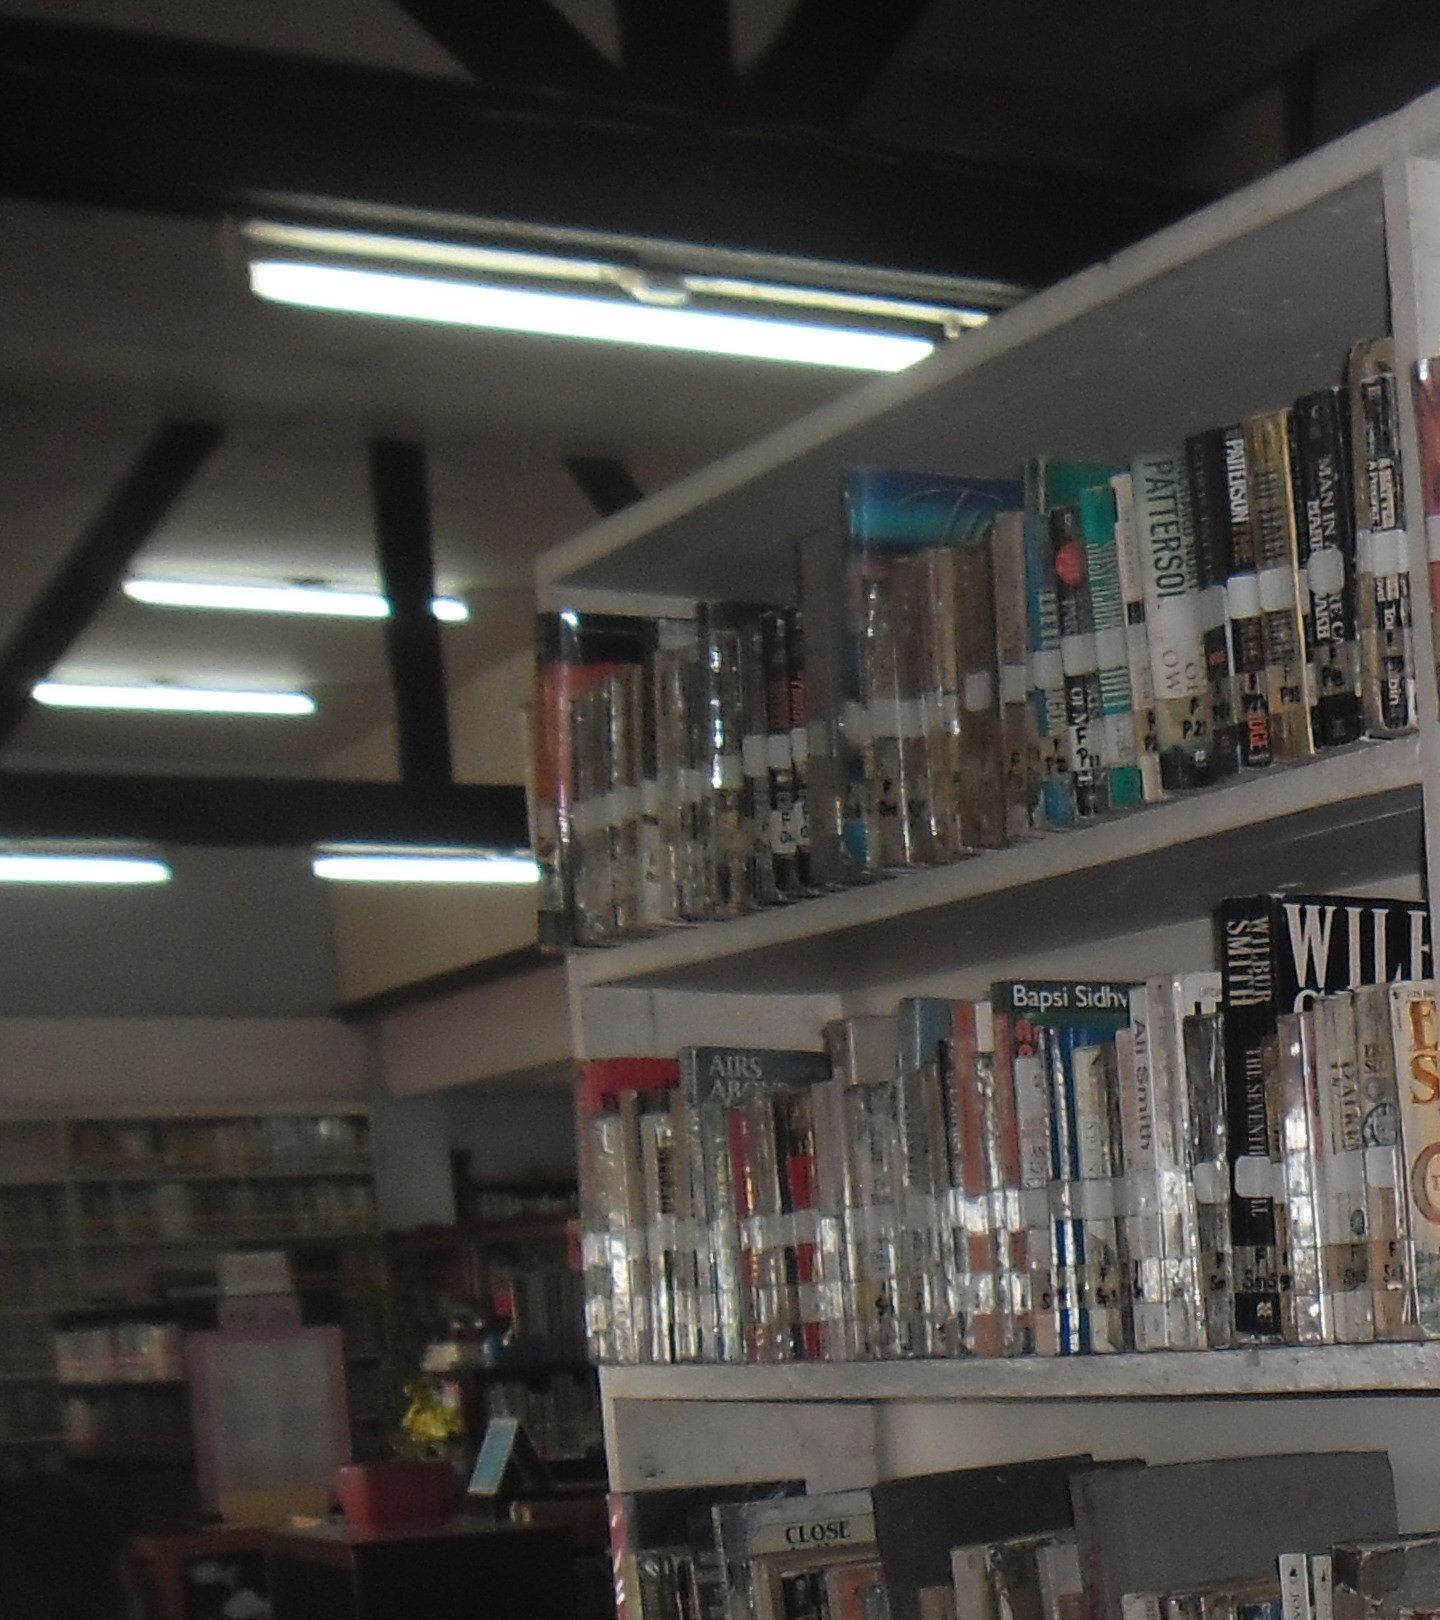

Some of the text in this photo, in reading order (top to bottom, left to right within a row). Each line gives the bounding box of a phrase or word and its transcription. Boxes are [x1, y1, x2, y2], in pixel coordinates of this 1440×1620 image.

[1226, 920, 1250, 1008] SMITH
[1013, 985, 1068, 1012] Bapsi
[785, 1521, 850, 1545] CLOSE
